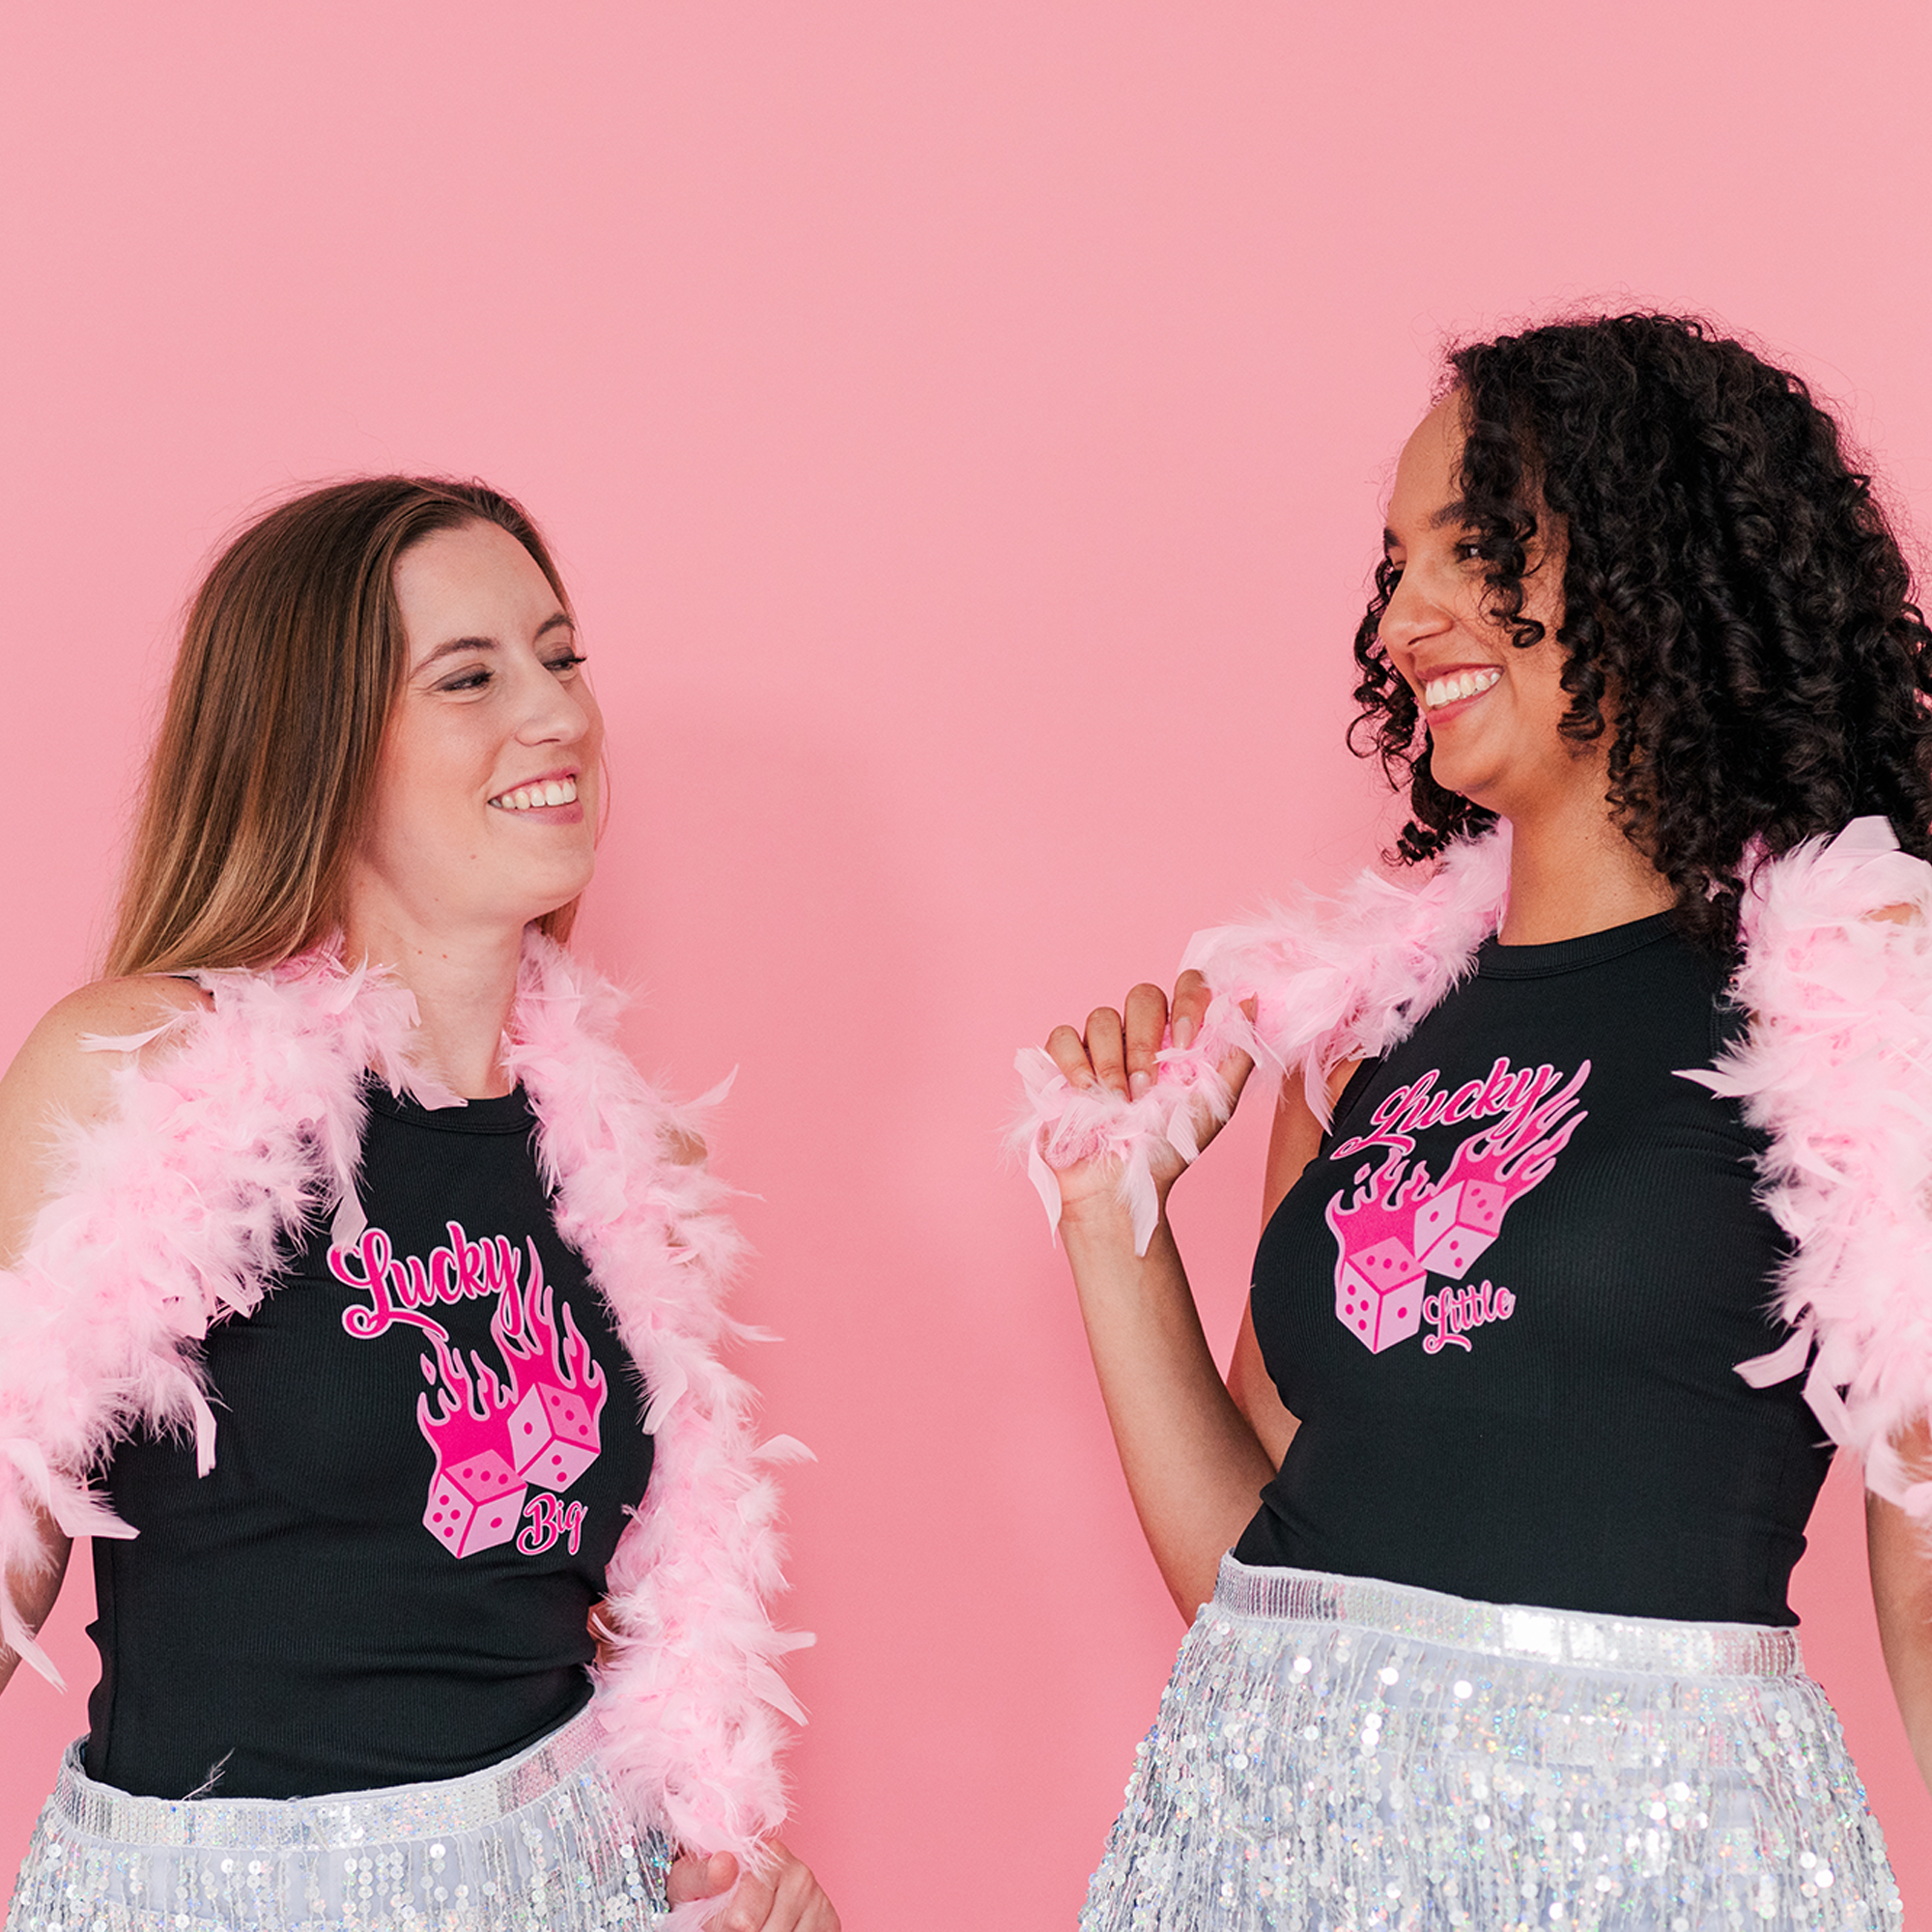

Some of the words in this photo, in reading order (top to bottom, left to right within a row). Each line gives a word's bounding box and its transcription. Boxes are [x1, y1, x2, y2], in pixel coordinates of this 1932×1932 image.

[1330, 1057, 1563, 1159] Lucky
[327, 1221, 521, 1341] Lucky
[1422, 1280, 1516, 1354] Little
[517, 1493, 587, 1555] Big
